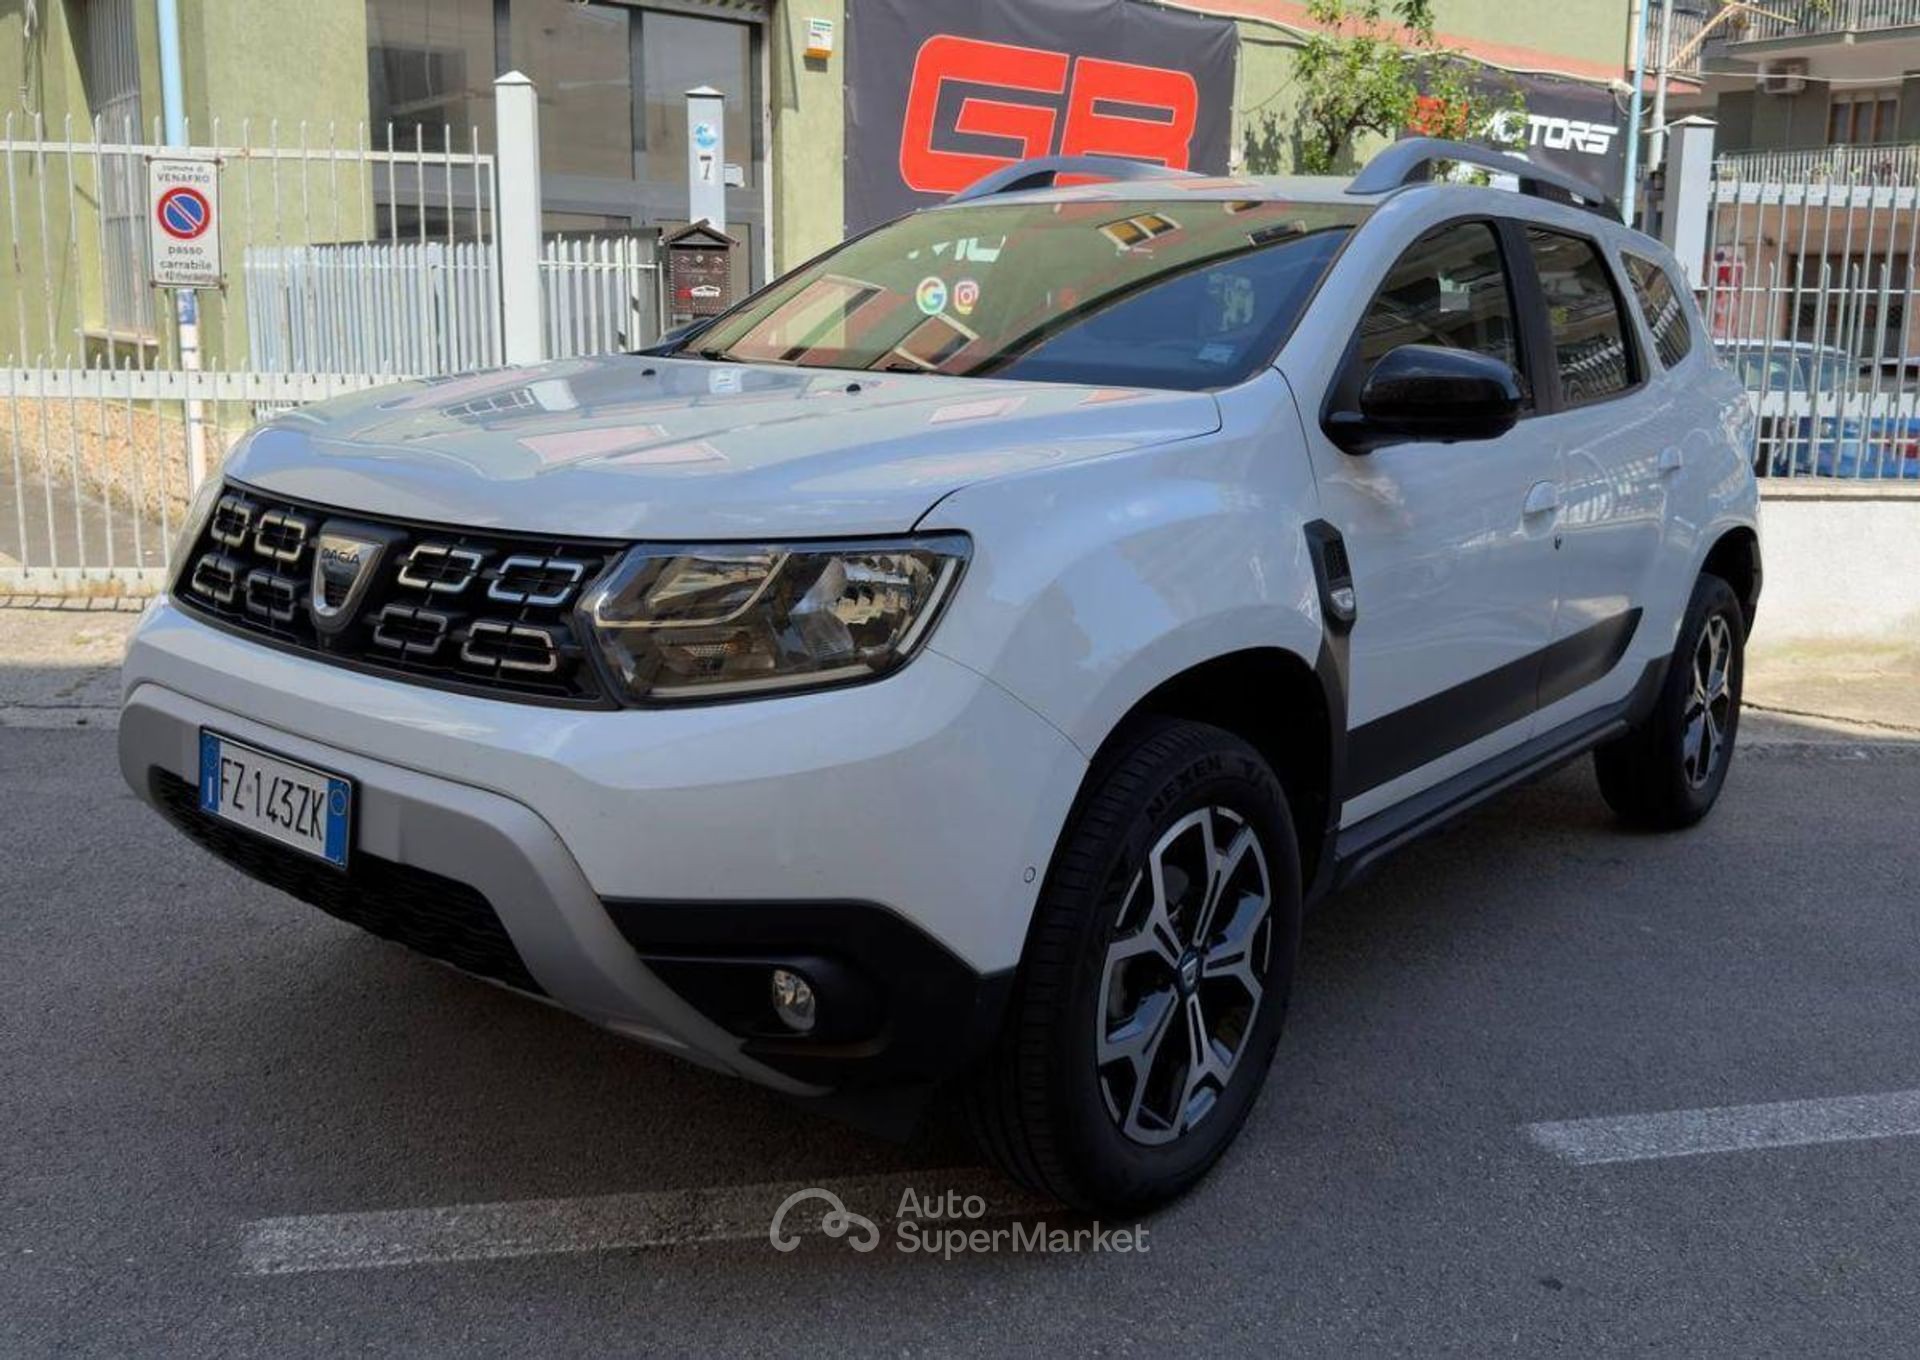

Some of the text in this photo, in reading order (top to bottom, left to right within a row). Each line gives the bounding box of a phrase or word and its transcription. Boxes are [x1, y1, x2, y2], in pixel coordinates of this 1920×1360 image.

[900, 34, 1198, 194] GB
[168, 246, 204, 256] passo
[160, 260, 212, 270] carrabile
[321, 548, 360, 564] DACIA
[1146, 755, 1222, 817] NEXEN
